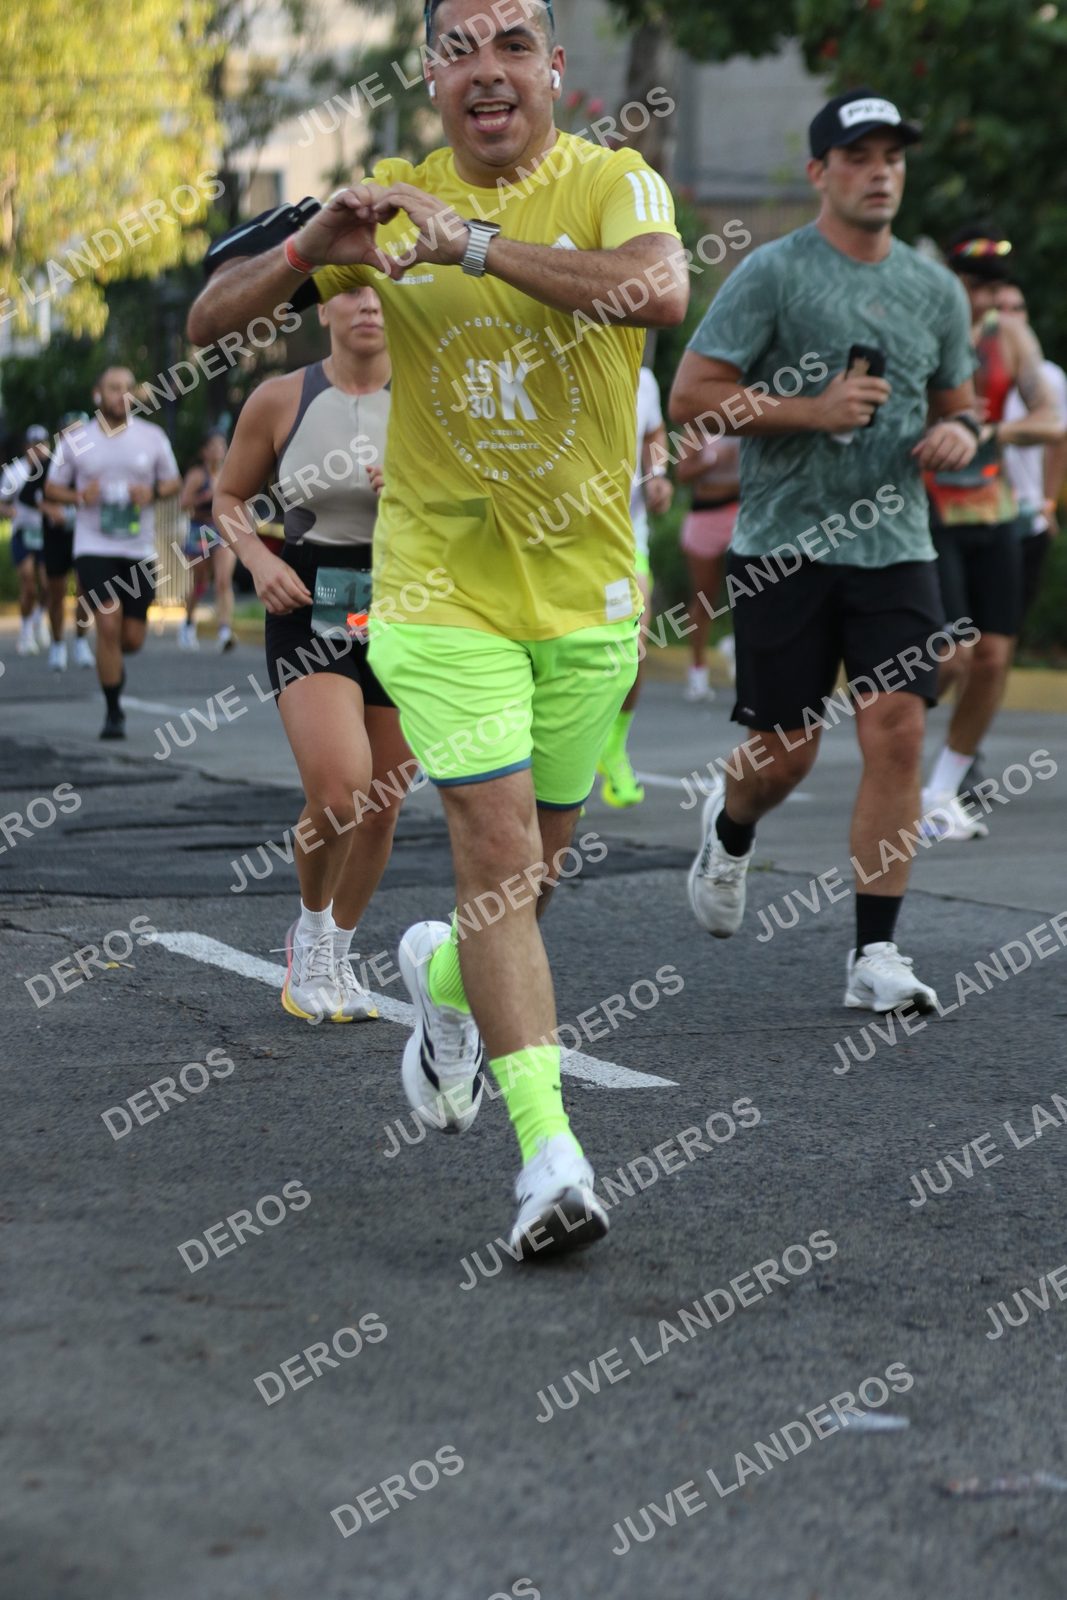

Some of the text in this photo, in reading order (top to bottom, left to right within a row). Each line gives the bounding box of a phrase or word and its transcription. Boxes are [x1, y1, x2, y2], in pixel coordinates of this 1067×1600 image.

[466, 358, 539, 420] 15 K
[468, 395, 497, 420] 30
